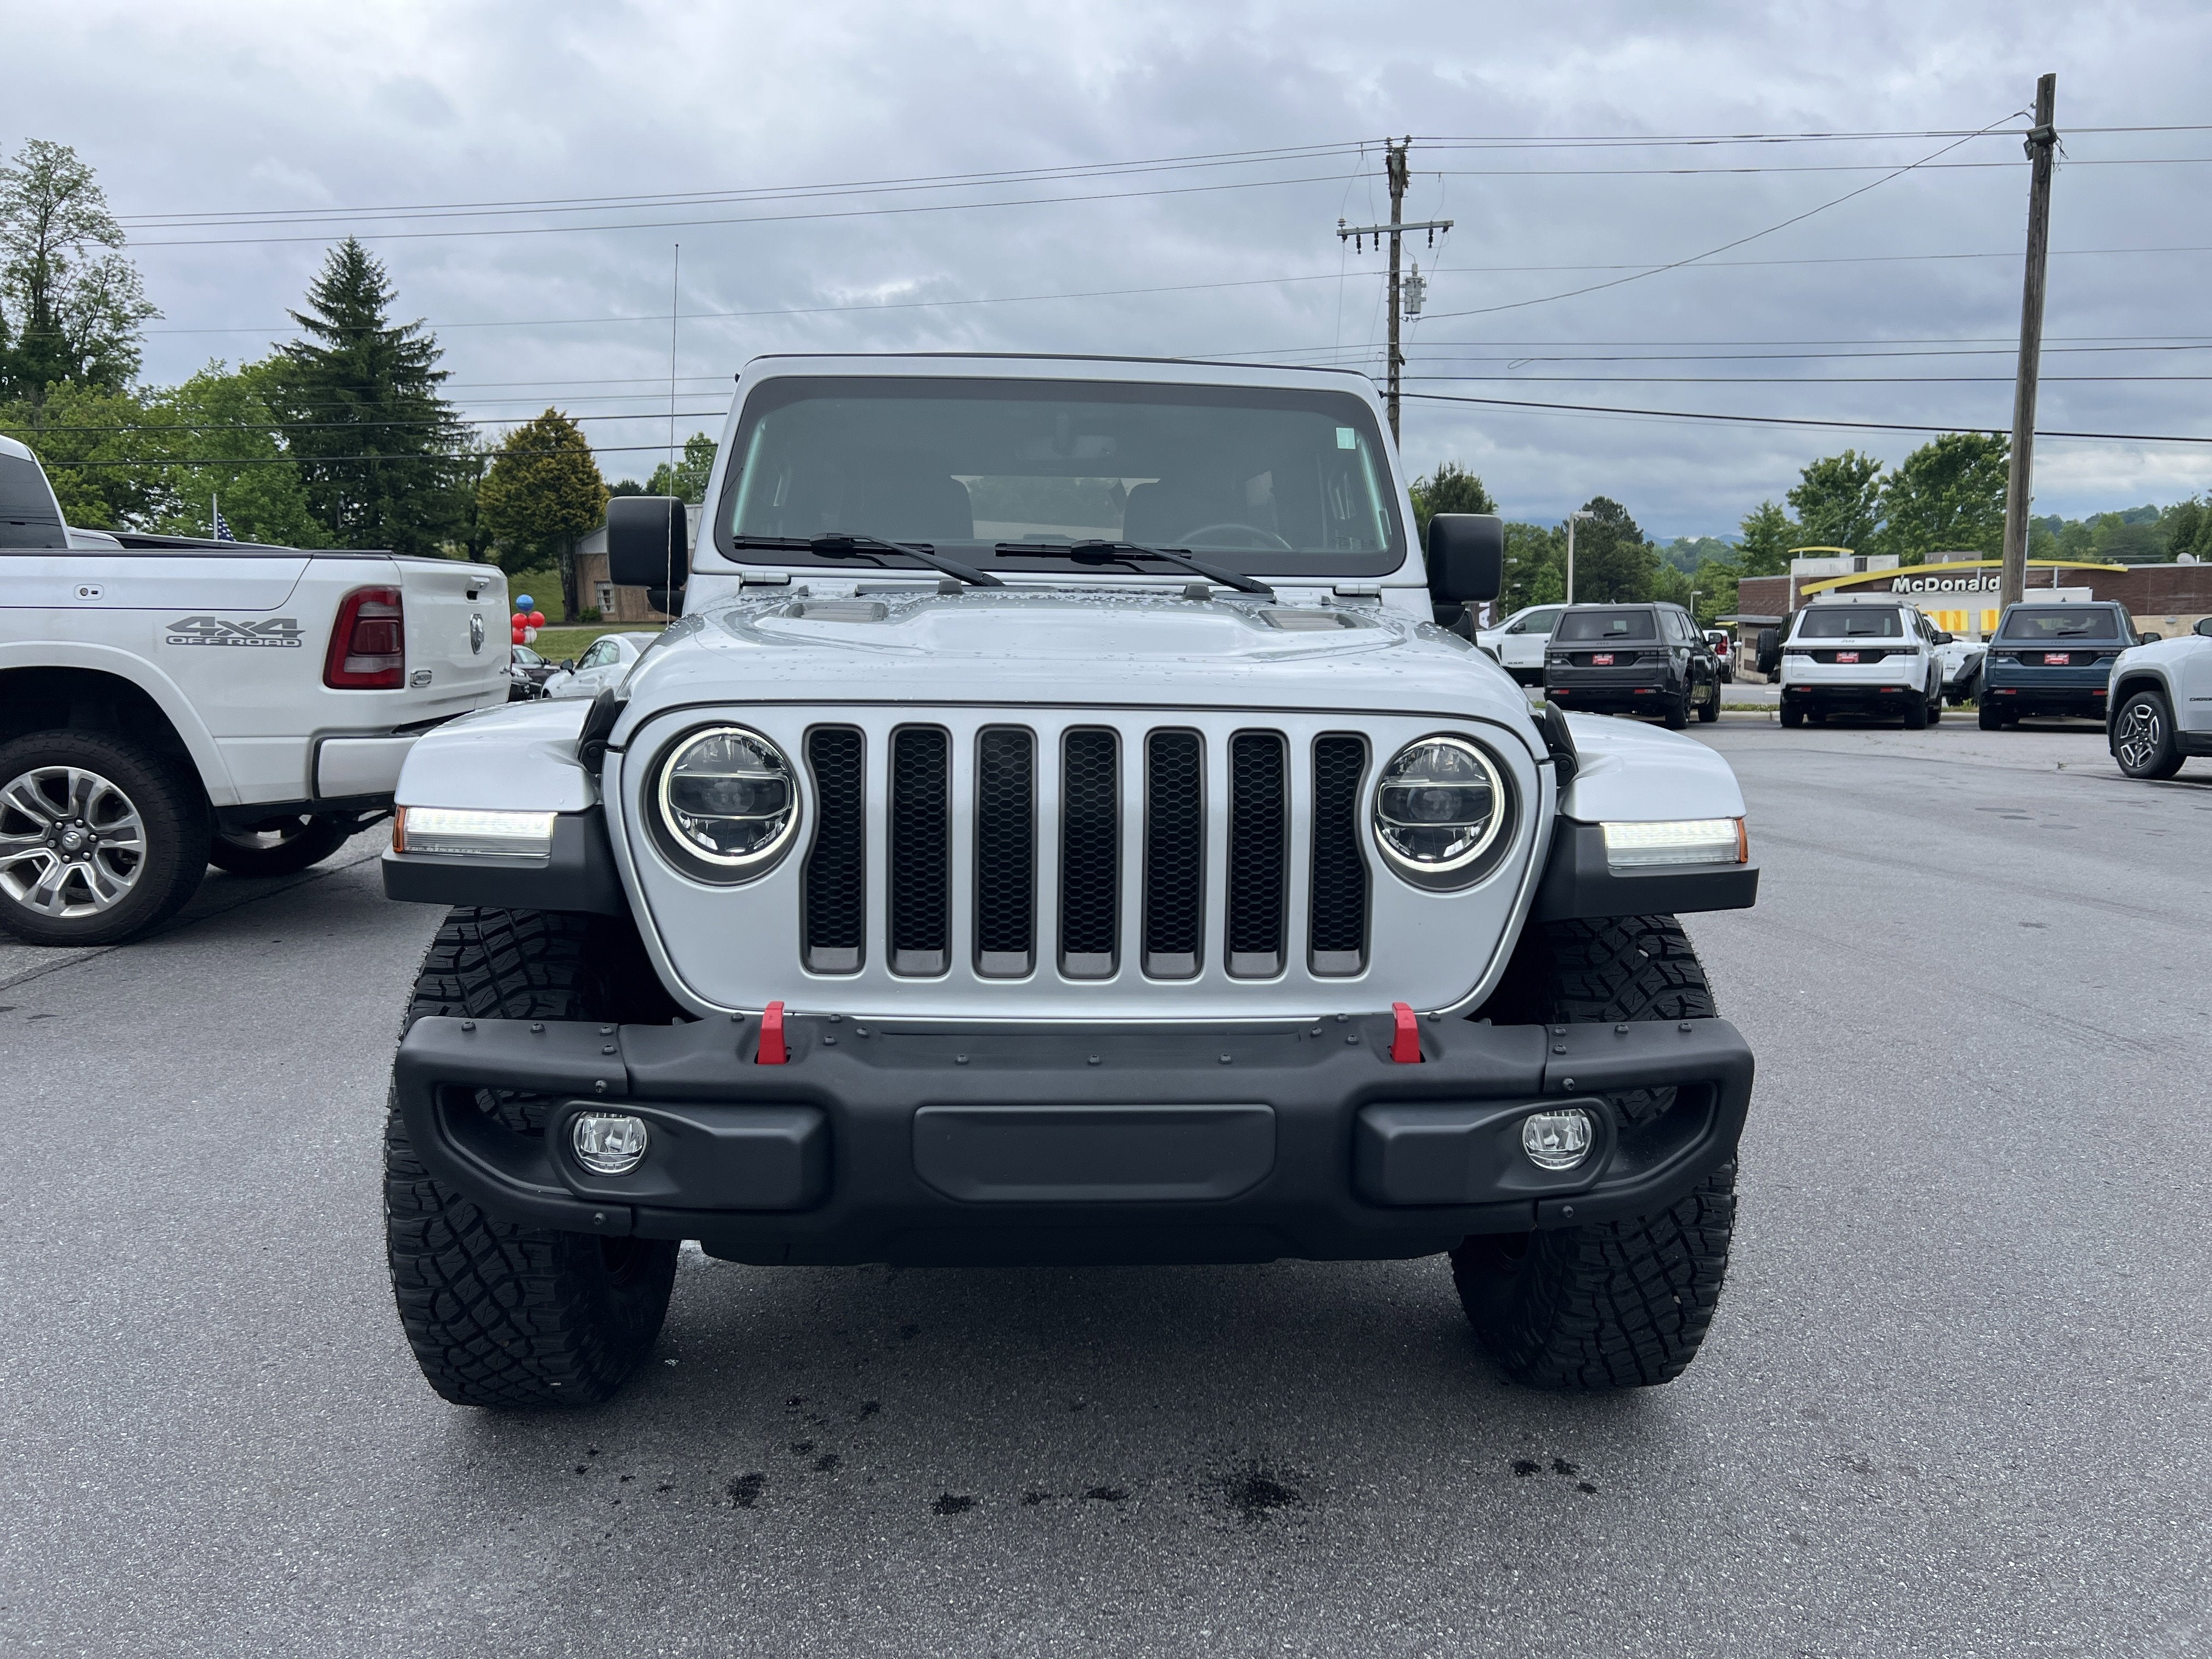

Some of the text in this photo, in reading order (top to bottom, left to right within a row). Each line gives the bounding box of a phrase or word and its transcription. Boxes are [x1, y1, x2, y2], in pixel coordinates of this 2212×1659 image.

[1892, 576, 2001, 592] McDonald
[168, 636, 300, 647] OFF ROAD
